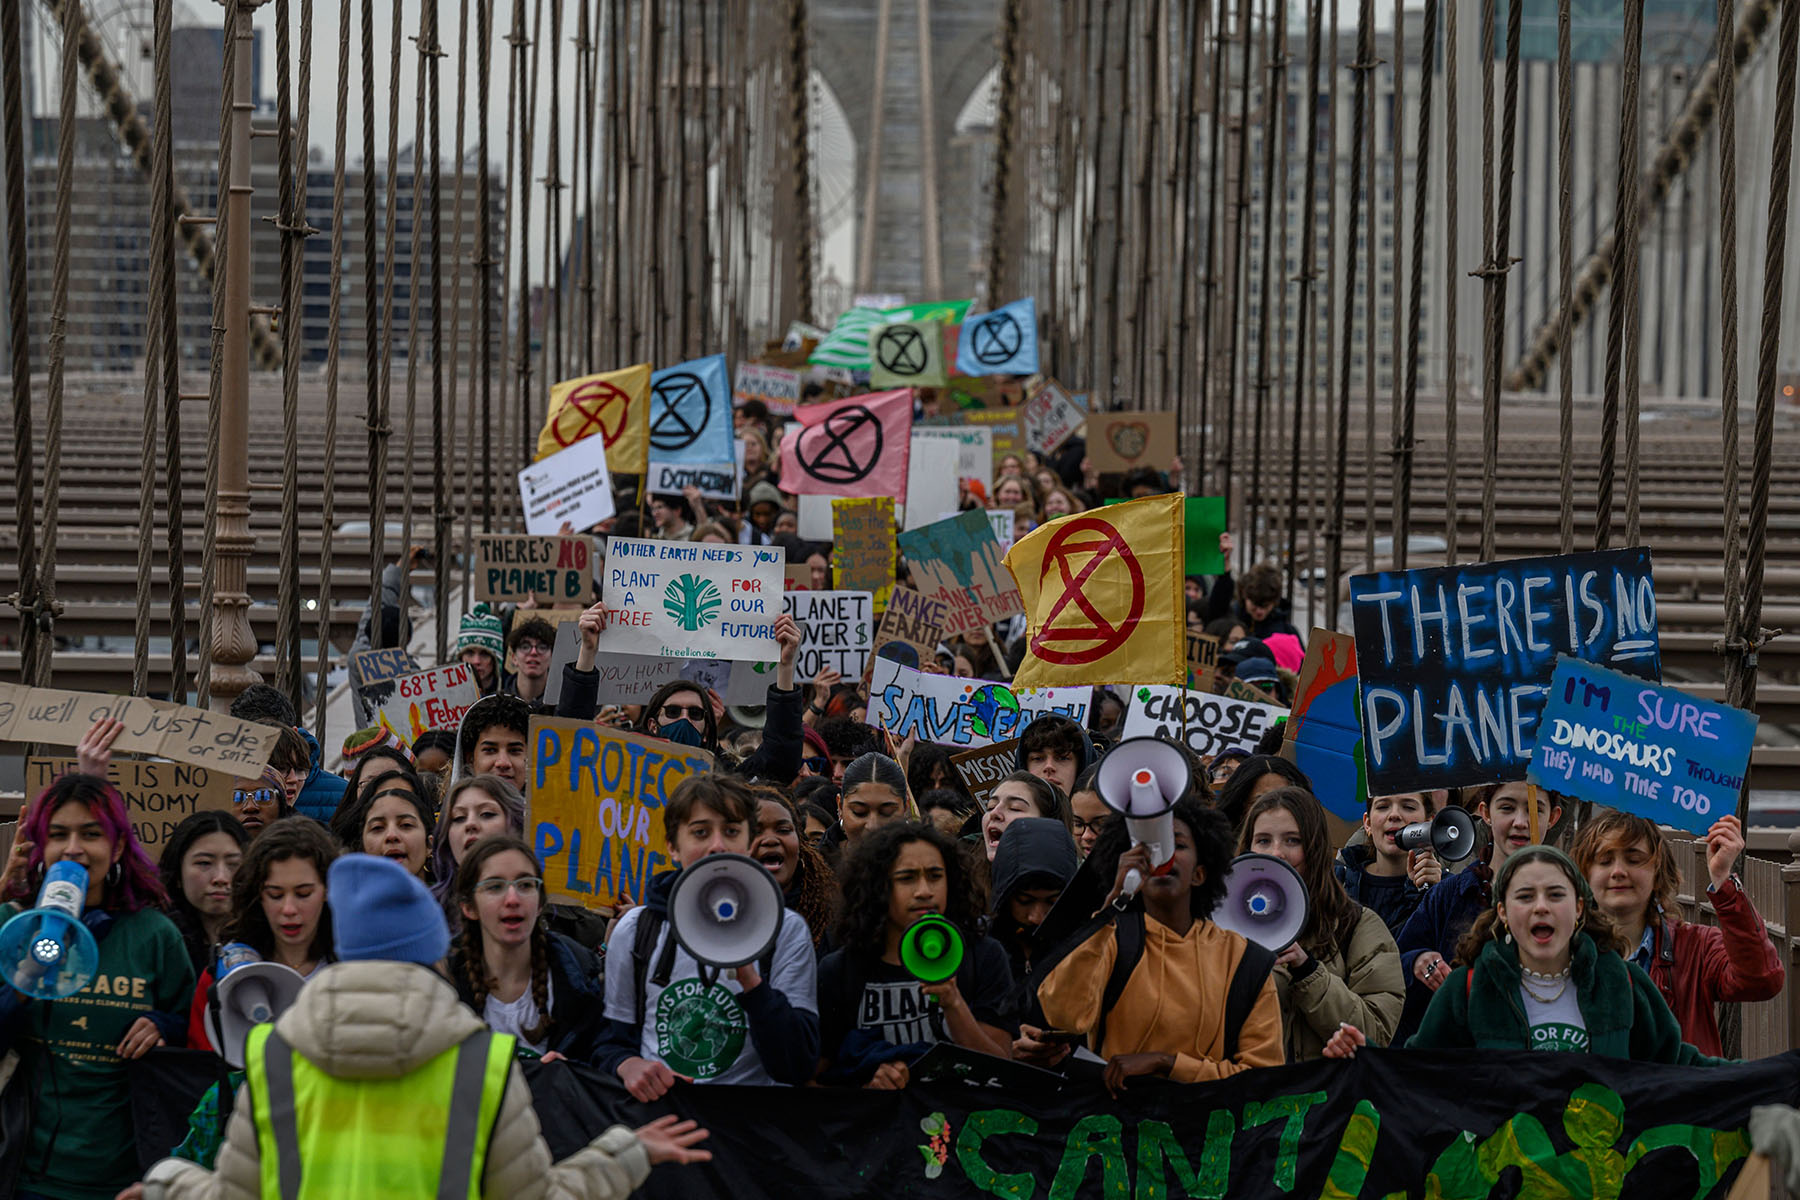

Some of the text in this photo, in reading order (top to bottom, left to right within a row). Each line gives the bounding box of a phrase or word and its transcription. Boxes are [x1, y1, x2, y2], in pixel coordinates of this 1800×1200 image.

[480, 538, 588, 571] THERE'S NO
[612, 541, 779, 567] MOTHER EARTH NEEDS YOU
[488, 568, 582, 597] PLANET B
[612, 569, 660, 588] PLANT
[732, 579, 762, 593] FOR
[624, 591, 635, 606] A
[730, 599, 764, 613] OUR
[891, 587, 948, 628] MAKE
[609, 609, 653, 626] TREE
[721, 622, 776, 640] FUTURE
[880, 610, 944, 650] EARTH
[1356, 570, 1657, 664] THERE IS NO
[801, 622, 868, 646] VER $
[358, 649, 411, 681] RISE
[443, 664, 468, 688] IN
[600, 663, 630, 681] YOU
[636, 661, 674, 679] HURT
[879, 683, 977, 744] SAVE
[992, 703, 1087, 743] EAH
[1144, 694, 1267, 742] CHOOSE
[1564, 676, 1722, 740] I'M SURE
[28, 697, 79, 722] we'll
[89, 701, 131, 722] all
[132, 708, 211, 740] just
[215, 724, 259, 751] die
[1366, 682, 1551, 767] PLANE
[1612, 714, 1649, 739] THE
[188, 743, 209, 758] or
[1551, 719, 1743, 791] DINOSAURS THOUGHT
[134, 764, 158, 788] IS
[175, 765, 208, 788] NO
[956, 749, 1016, 787] MISSIN
[1541, 745, 1711, 815] THEY HAD TIME TOO
[120, 793, 200, 814] NOMY
[599, 797, 650, 845] OUR
[534, 822, 681, 906] PLANE
[656, 982, 744, 1058] FRIDAYS FOR FUTURE
[1531, 1027, 1558, 1041] OR
[697, 1062, 721, 1076] U.S.
